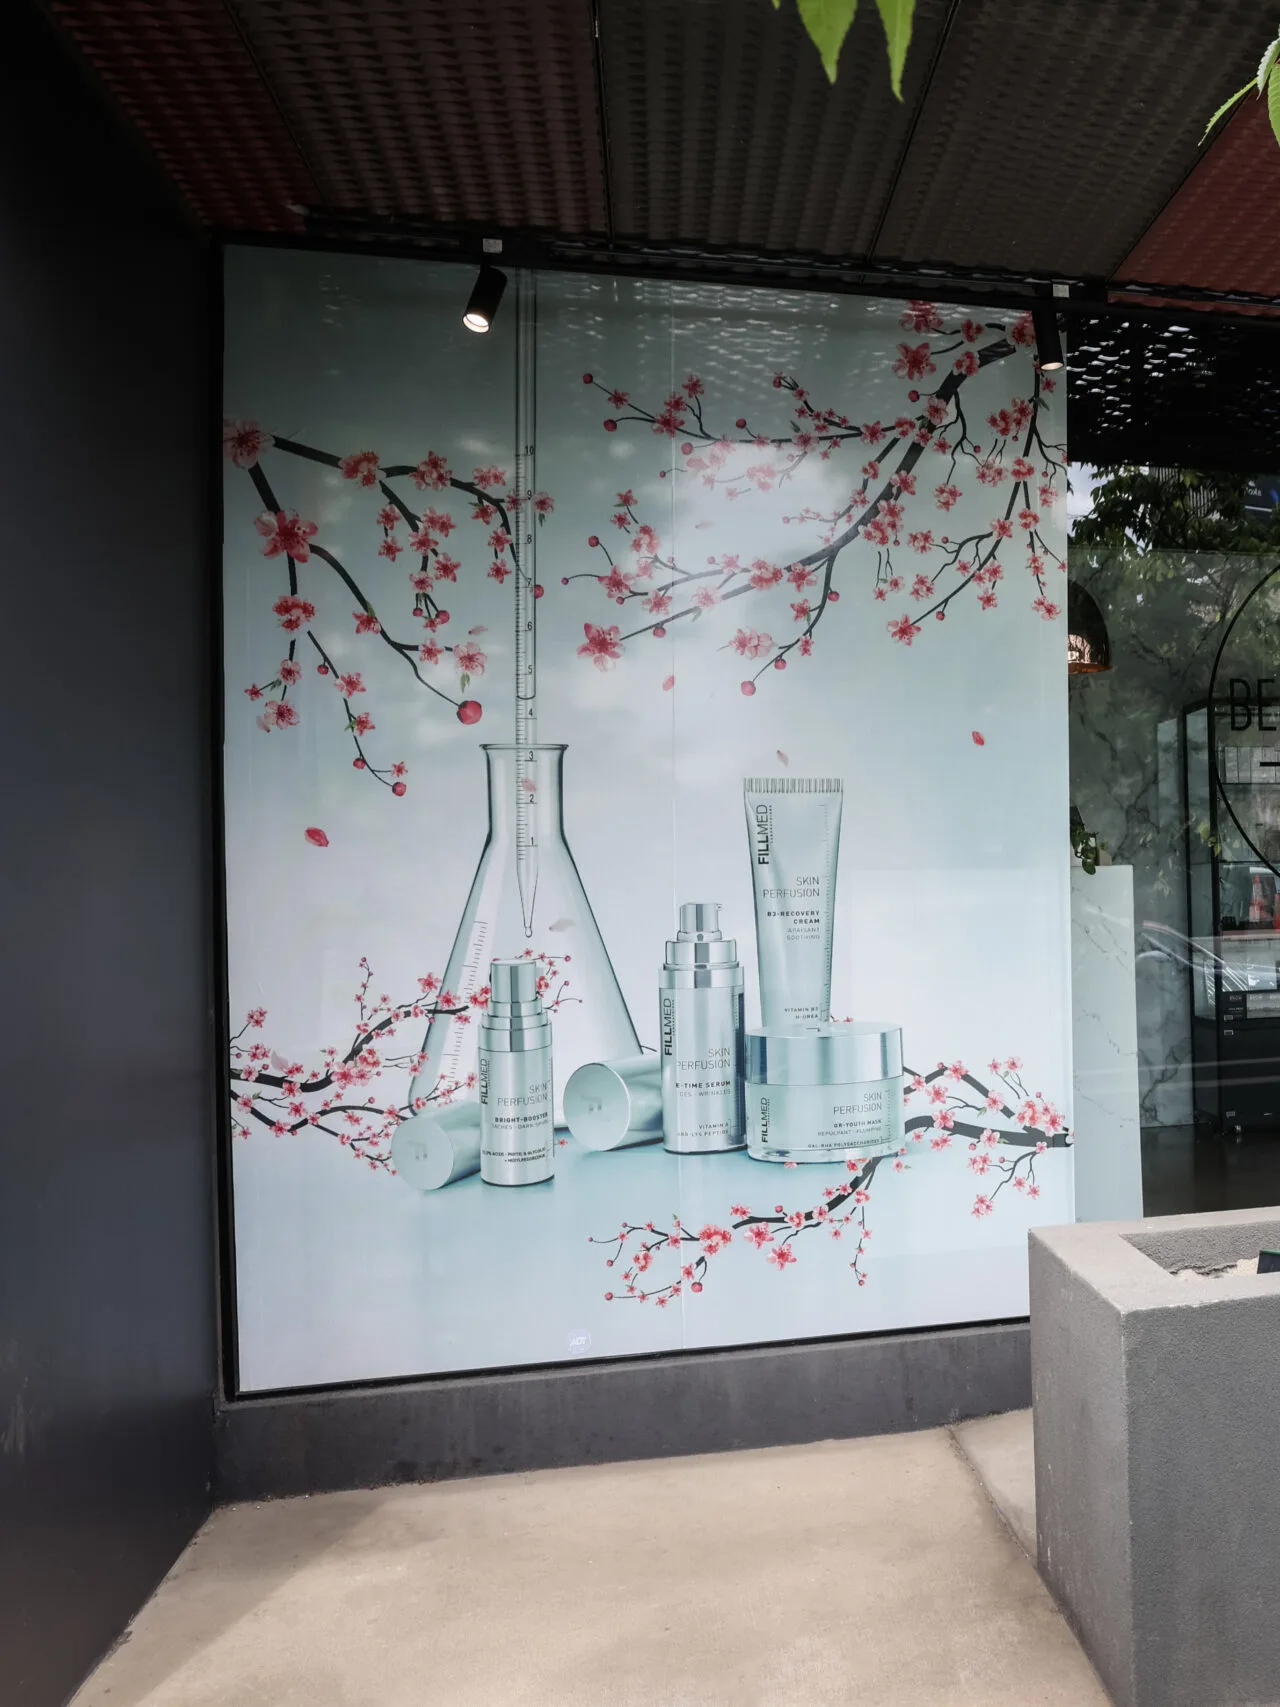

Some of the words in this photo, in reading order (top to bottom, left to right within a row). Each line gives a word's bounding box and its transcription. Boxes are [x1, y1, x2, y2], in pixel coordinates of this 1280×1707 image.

[525, 445, 534, 455] 10
[526, 490, 532, 499] 9
[526, 534, 533, 543] 8
[526, 578, 532, 587] 7
[527, 622, 533, 631] 6
[527, 665, 533, 674] 5
[528, 708, 533, 716] 4
[528, 751, 534, 760] 3
[529, 794, 534, 803] 2
[756, 804, 769, 865] FILLMED
[796, 876, 820, 886] SKIN
[762, 888, 820, 899] PERFUSION
[663, 998, 673, 1056] FILLMED
[708, 1047, 731, 1058] SKIN
[676, 1059, 731, 1071] PERFUSION
[480, 1058, 488, 1105] FILLMED
[705, 1080, 731, 1088] SERUM
[529, 1083, 548, 1094] SKIN
[497, 1094, 548, 1107] PERFUSION
[863, 1091, 882, 1102] SKIN
[833, 1102, 882, 1115] PERFUSION
[494, 1112, 548, 1123] BRIGHT-BOOSTER
[760, 1097, 769, 1143] FILLMED
